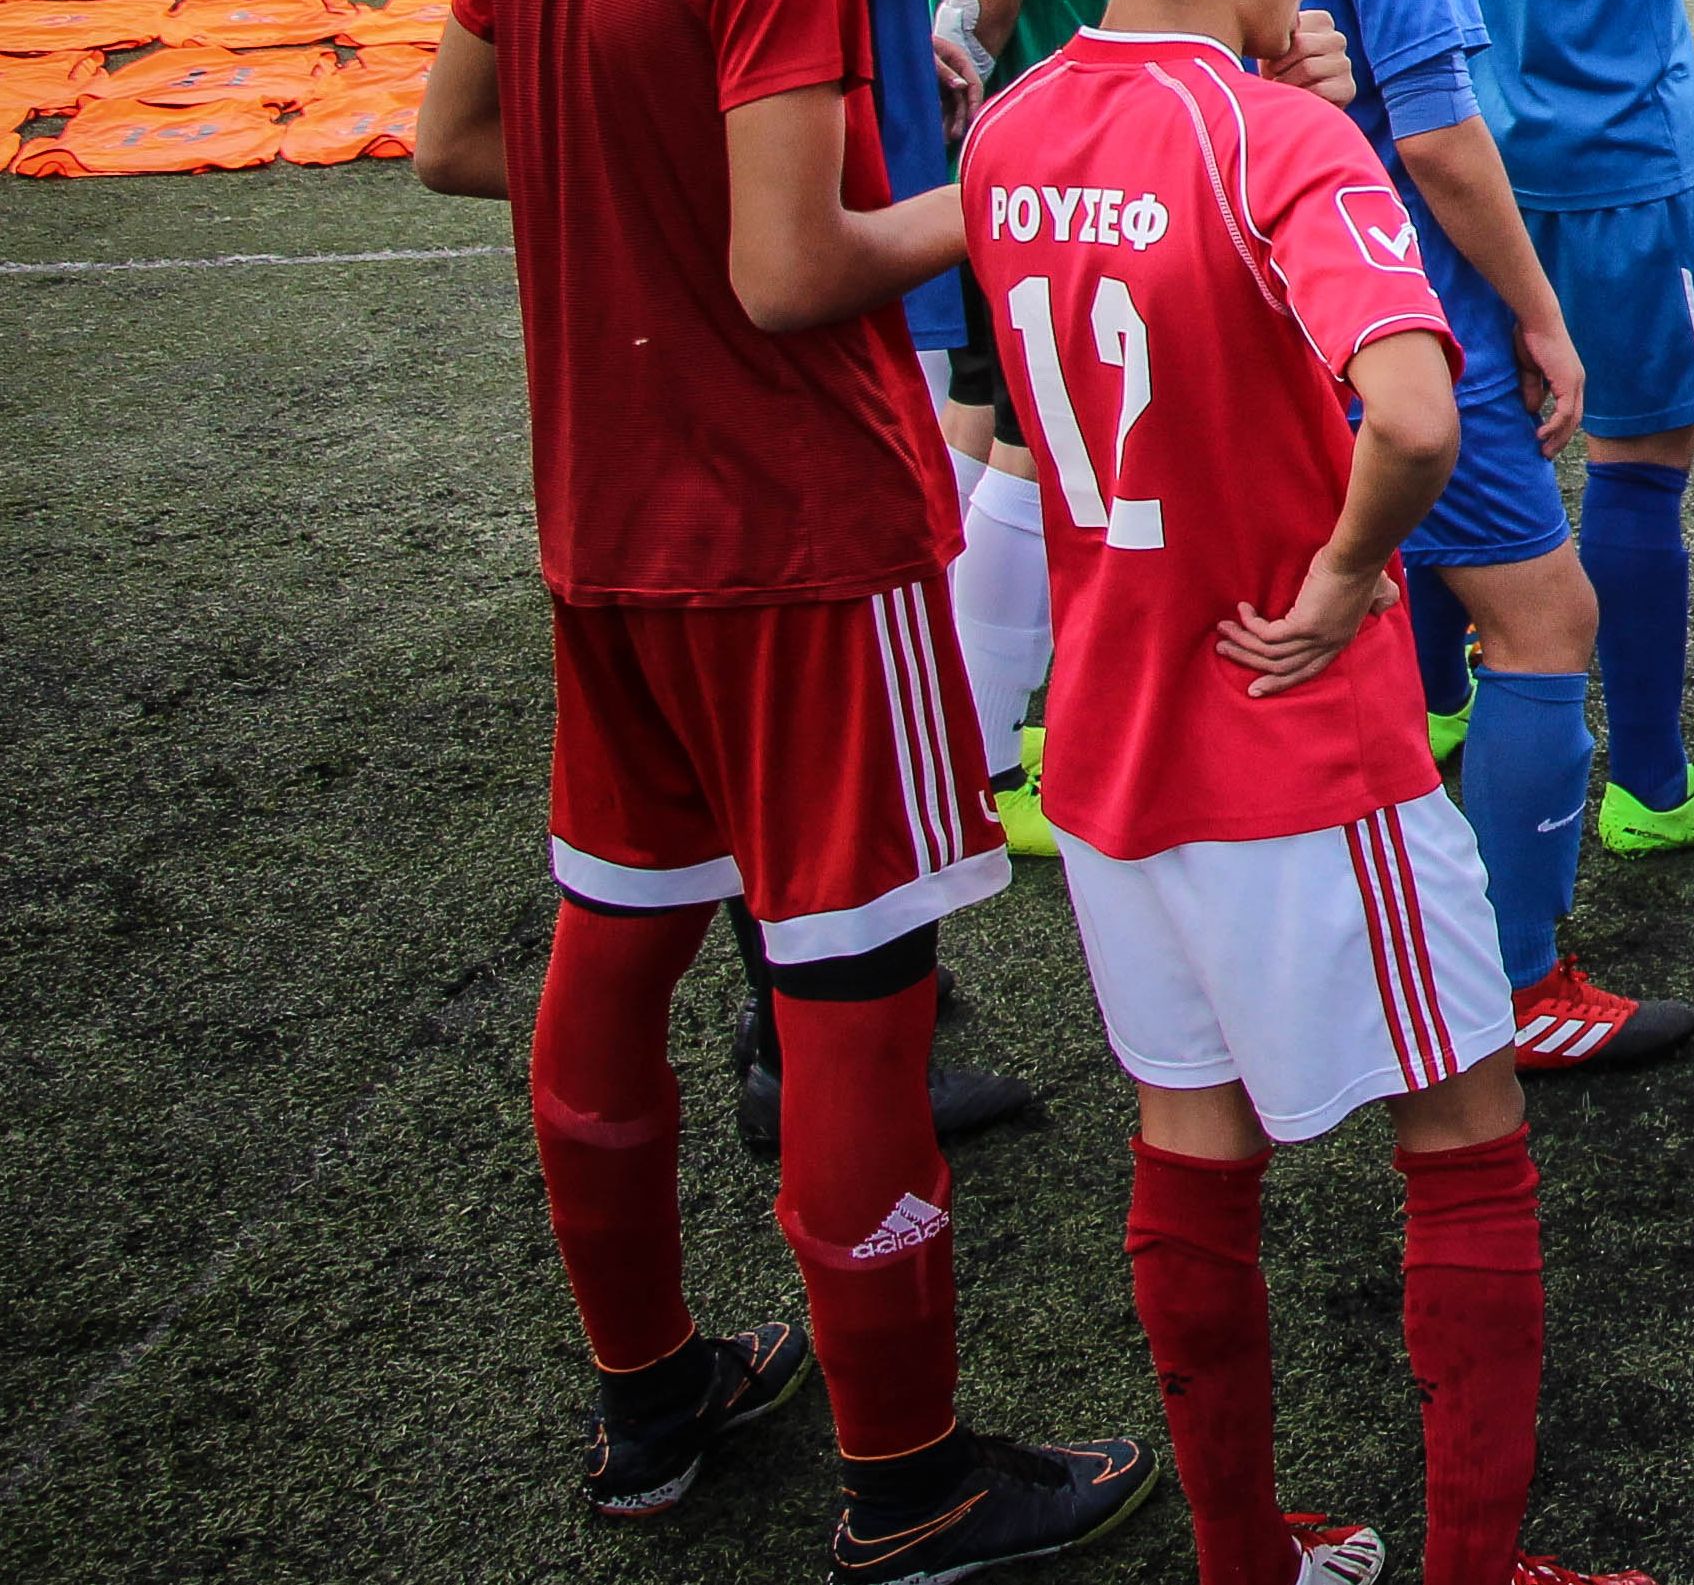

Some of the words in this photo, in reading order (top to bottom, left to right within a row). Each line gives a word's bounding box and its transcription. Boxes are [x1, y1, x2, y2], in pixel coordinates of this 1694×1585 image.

[990, 186, 1169, 251] ΡΟΥΣΕΦ
[1008, 276, 1165, 549] 12
[852, 1211, 950, 1259] adidas
